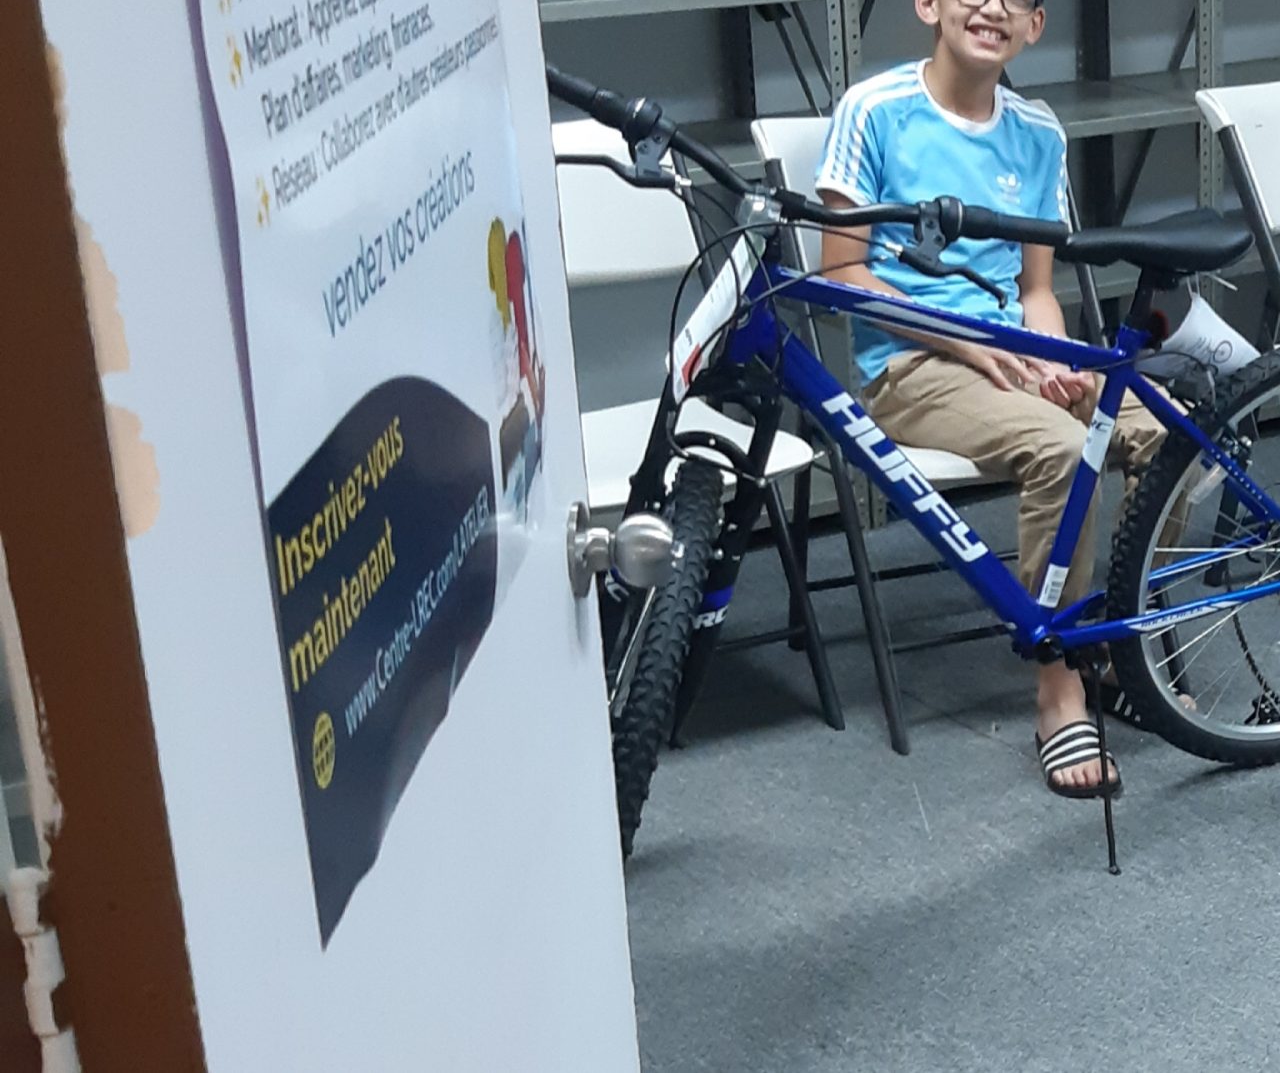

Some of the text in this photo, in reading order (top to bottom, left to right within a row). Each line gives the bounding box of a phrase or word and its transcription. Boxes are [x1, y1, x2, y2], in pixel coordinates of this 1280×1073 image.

[243, 4, 303, 74] Mentorat
[261, 88, 294, 140] Plan
[272, 151, 318, 212] Réseau
[322, 150, 475, 338] vendez vos créations
[275, 415, 405, 597] Inscrivez-vous
[822, 392, 989, 563] HUFFY
[288, 516, 397, 693] maintenant
